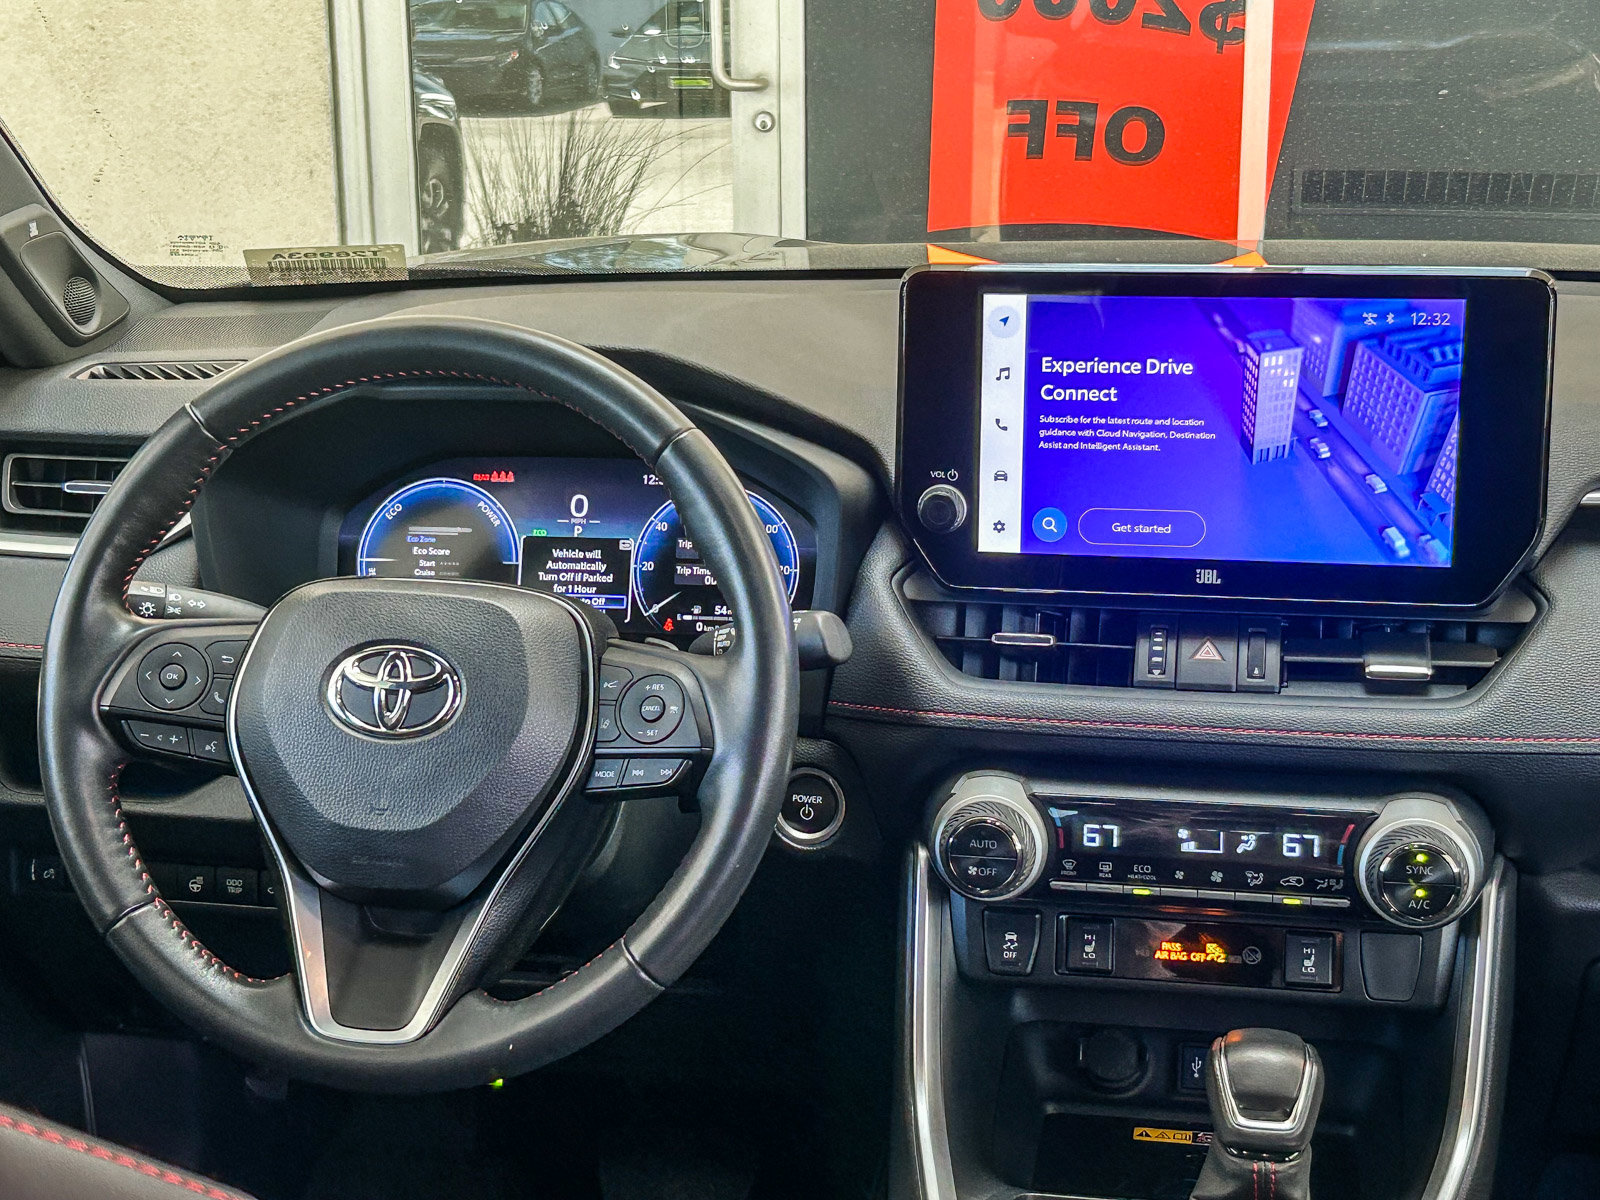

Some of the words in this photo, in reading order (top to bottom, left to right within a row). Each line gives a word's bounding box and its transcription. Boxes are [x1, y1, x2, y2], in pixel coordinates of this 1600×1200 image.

[1410, 312, 1451, 326] 12:32
[1041, 356, 1142, 377] Experience
[1146, 358, 1194, 375] Drive
[1040, 384, 1118, 402] Connect
[1039, 415, 1079, 424] Subscribe
[1080, 415, 1091, 424] for
[1093, 415, 1106, 425] the
[1107, 416, 1130, 425] latest
[1131, 417, 1153, 425] route
[1154, 417, 1170, 426] and
[1172, 417, 1205, 427] location
[1038, 428, 1077, 438] guidance
[1078, 428, 1095, 437] with
[1096, 429, 1121, 438] Cloud
[1122, 429, 1168, 440] Navigation,
[1169, 430, 1216, 440] Destination
[1038, 440, 1062, 449] Assist
[1063, 441, 1079, 450] and
[1080, 441, 1121, 452] Intelligent
[1122, 442, 1161, 451] Assistant.
[930, 470, 946, 479] VOL
[384, 503, 403, 520] ECO
[570, 494, 589, 518] 0
[477, 501, 501, 528] POWER
[574, 525, 583, 537] P
[656, 522, 668, 532] 40
[765, 524, 779, 534] 00
[1112, 522, 1132, 533] Get
[1134, 524, 1172, 534] started
[406, 535, 419, 543] Eco
[678, 539, 693, 550] Trip
[412, 546, 427, 556] Eco
[428, 547, 451, 556] Score
[552, 549, 584, 558] Vehicle
[585, 549, 602, 559] will
[419, 559, 436, 568] Start
[546, 560, 607, 573] Automatically
[642, 561, 655, 571] 20
[676, 566, 692, 576] Trip
[1195, 568, 1221, 585] JBL
[538, 571, 558, 581] Turn
[559, 572, 574, 581] Off
[575, 572, 582, 581] if
[583, 572, 614, 583] Parked
[553, 584, 566, 593] for
[568, 584, 572, 593] 1
[573, 585, 597, 594] Hour
[591, 597, 606, 606] Off
[714, 605, 728, 615] 54
[695, 621, 703, 632] 0
[595, 770, 615, 778] MODE
[792, 794, 823, 804] POWER
[1082, 823, 1119, 848] 67
[969, 839, 998, 850] AUTO
[1282, 833, 1320, 858] 67
[978, 867, 998, 877] OFF
[1133, 864, 1152, 873] ECO
[1406, 865, 1434, 876] SYNC
[1408, 900, 1430, 910] A/C
[1161, 941, 1182, 951] PASS
[1003, 951, 1018, 959] OFF
[1154, 950, 1169, 959] AIR
[1169, 951, 1187, 961] BAG
